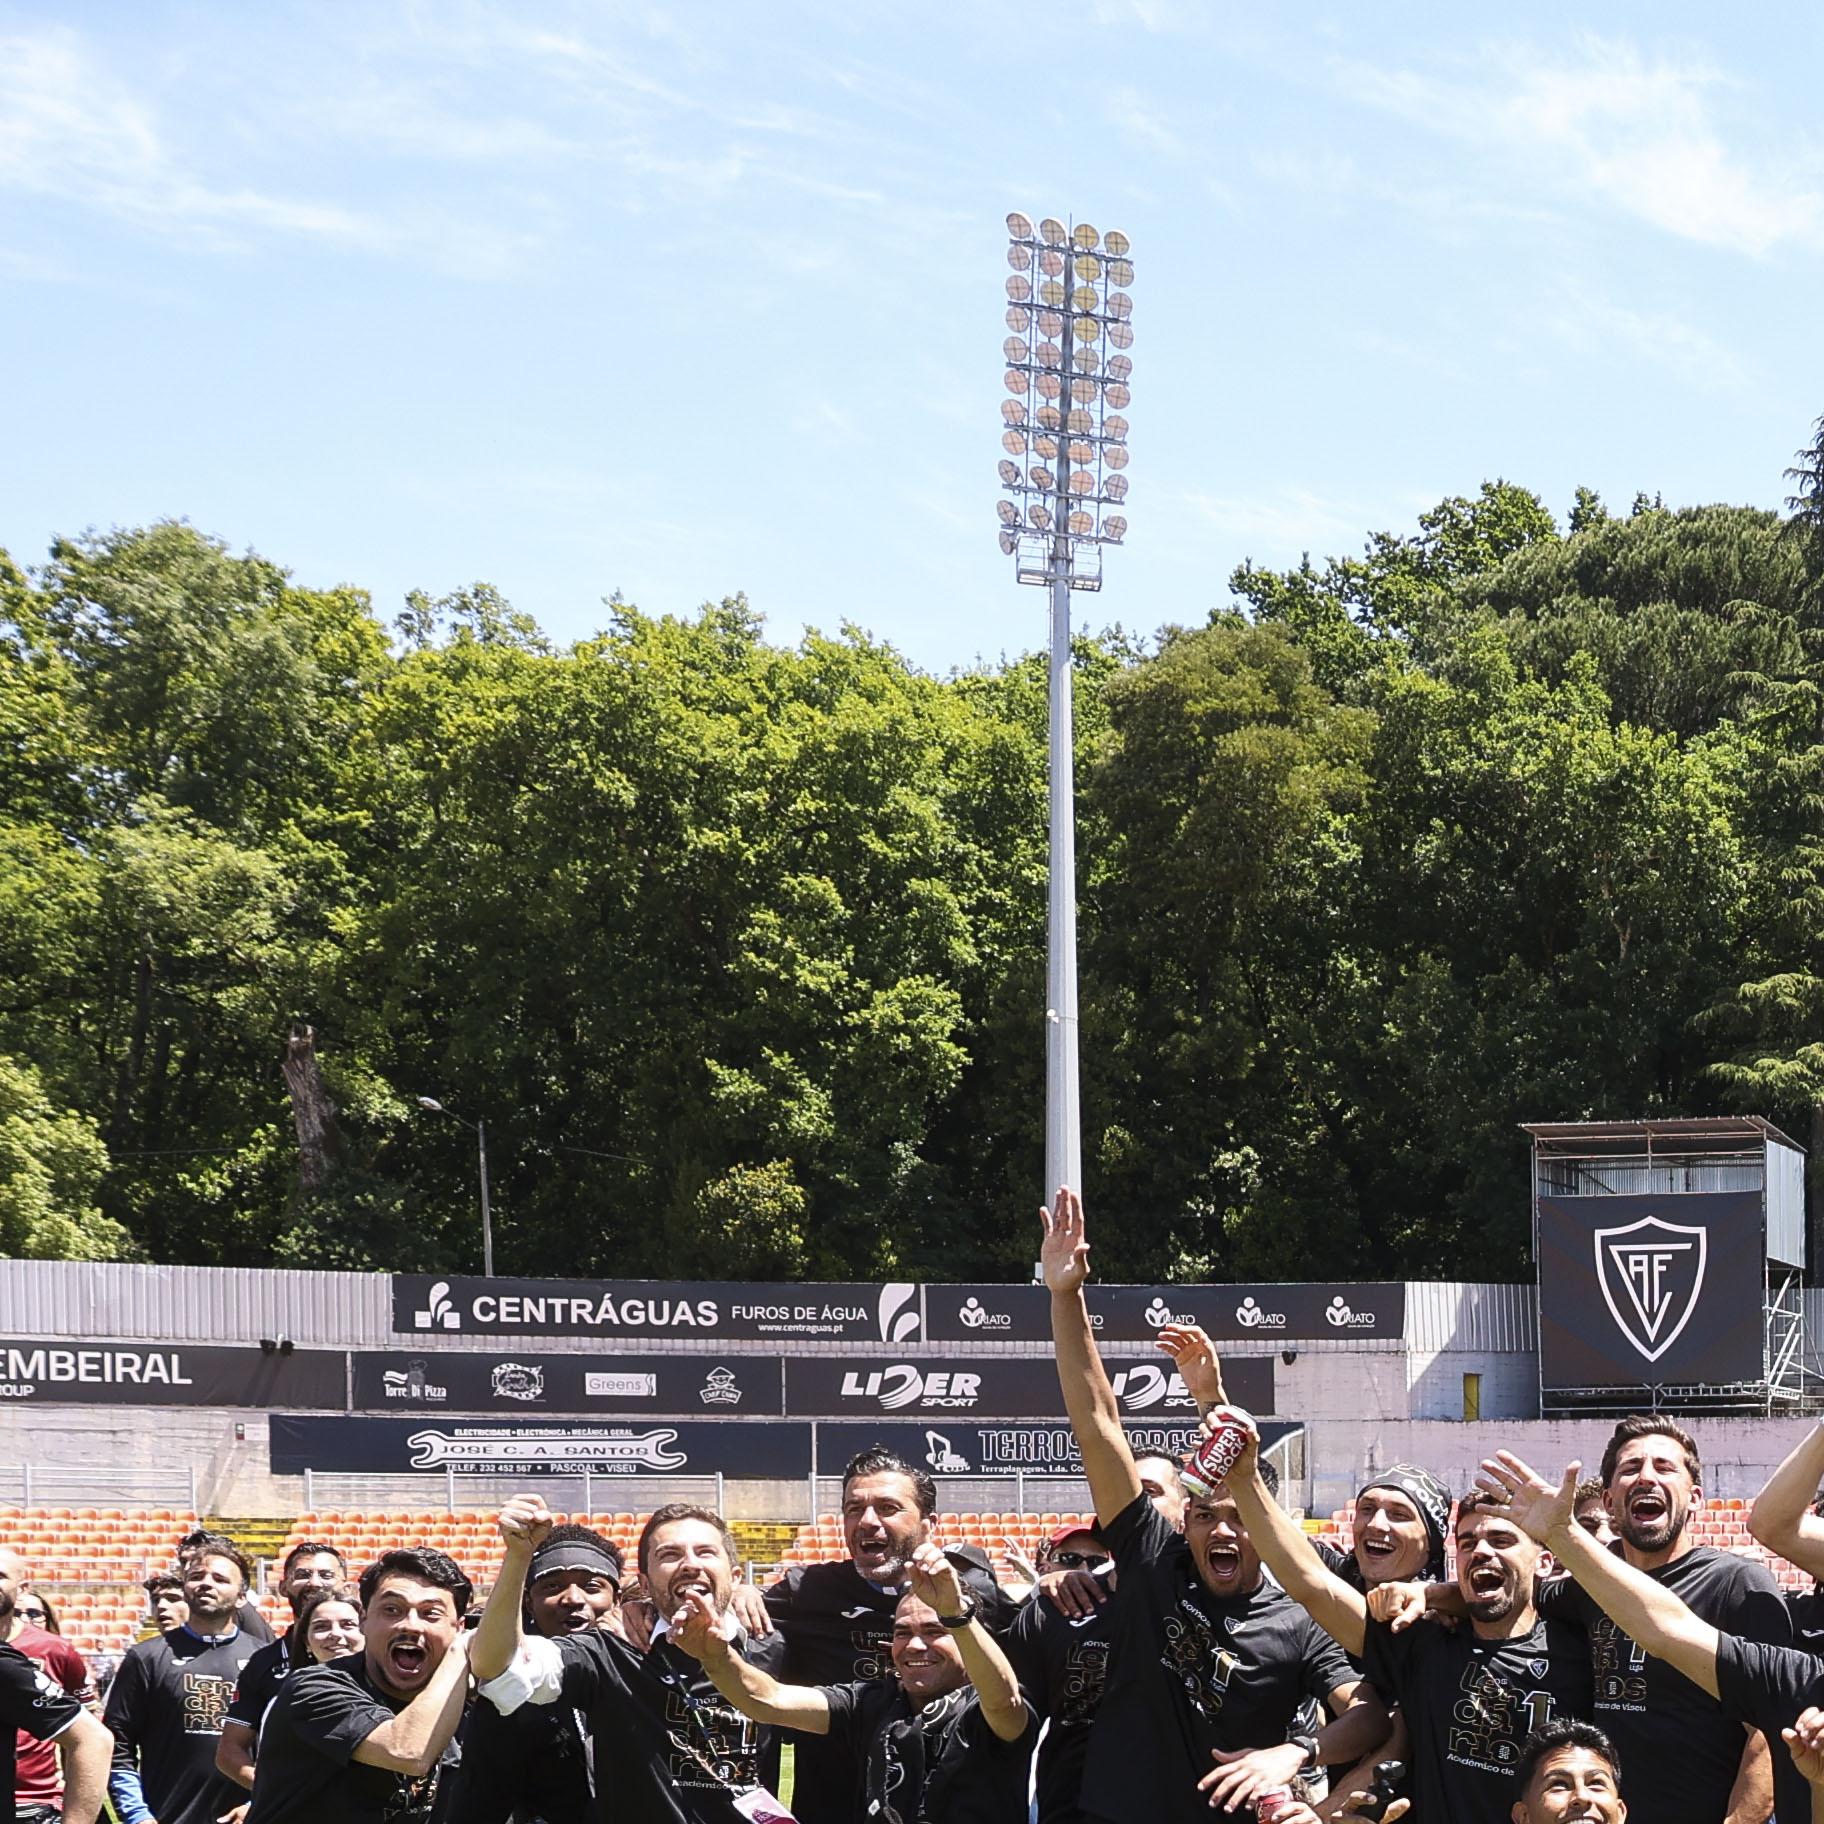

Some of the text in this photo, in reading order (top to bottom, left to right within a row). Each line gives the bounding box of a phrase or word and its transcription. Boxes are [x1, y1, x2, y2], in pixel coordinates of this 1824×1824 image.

[472, 1294, 719, 1327] CENTRÁGUAS
[731, 1304, 868, 1321] FUROS DE ÁGUA
[758, 1323, 843, 1334] www.centraguas.pt
[589, 1377, 642, 1391] Greens
[384, 1384, 408, 1398] Torre
[424, 1384, 447, 1398] Pizza
[920, 1398, 979, 1408] SPORT
[1163, 1398, 1198, 1407] SPO
[440, 1443, 649, 1456] JOSÉ C. A. SANTOS
[1203, 1428, 1239, 1468] SUPER
[446, 1463, 637, 1473] TELEF. 232 452 567 PASCOAL VISEU
